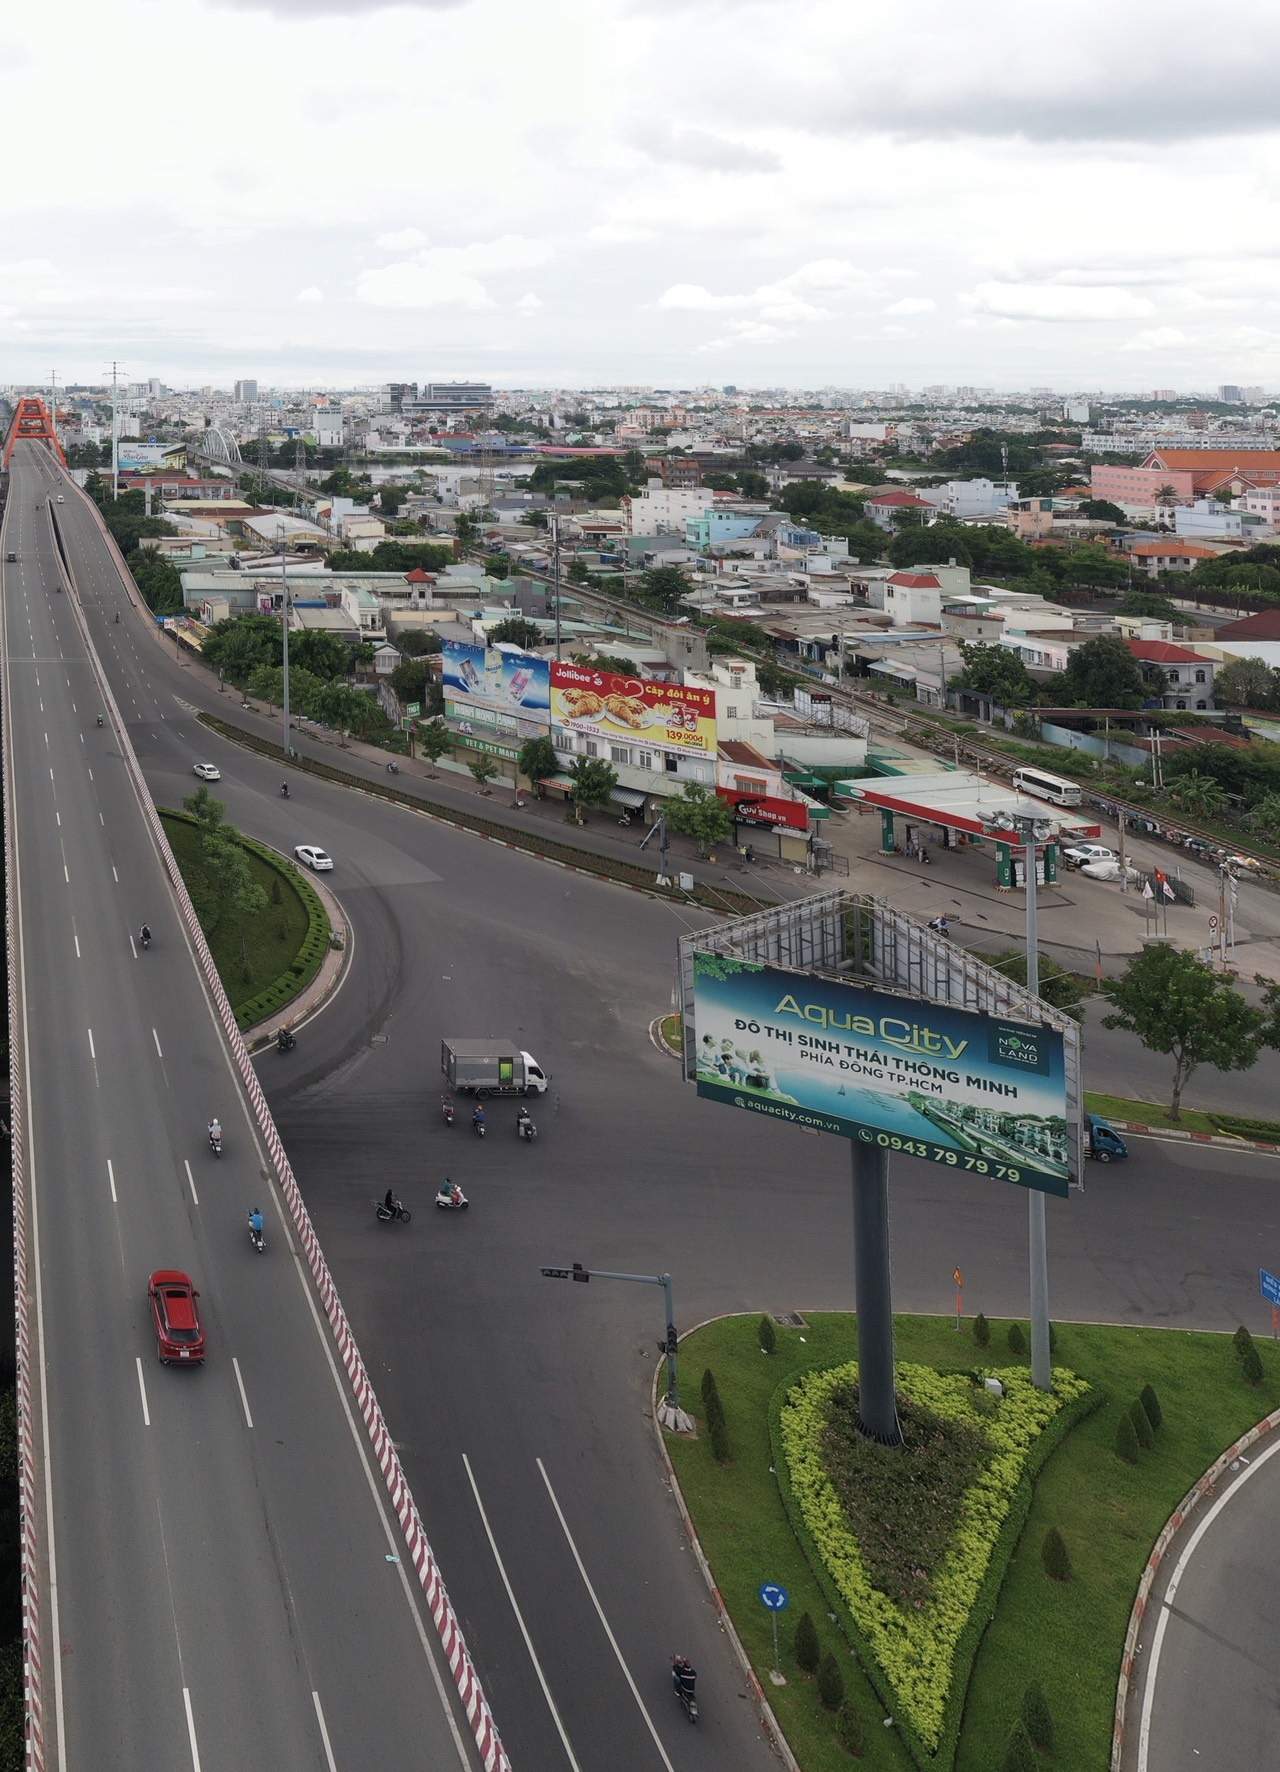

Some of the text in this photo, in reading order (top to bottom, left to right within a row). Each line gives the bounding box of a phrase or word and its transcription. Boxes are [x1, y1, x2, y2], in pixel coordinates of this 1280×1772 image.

[556, 668, 591, 683] Jollibee
[666, 688, 684, 700] đôi
[686, 692, 700, 703] ăn
[570, 721, 600, 734] 1900-1533
[665, 729, 703, 743] 139.000đ
[465, 738, 519, 760] VET & PET MART
[734, 1018, 1018, 1099] ĐÔ THỊ SINH THÁI THÔNG MINH
[999, 1047, 1038, 1062] LAND
[800, 1050, 942, 1094] PHÍA ĐÔNG TP.HCM
[747, 1099, 840, 1132] aquacity.com.vn
[877, 1133, 1020, 1182] 0943 79 79 79
